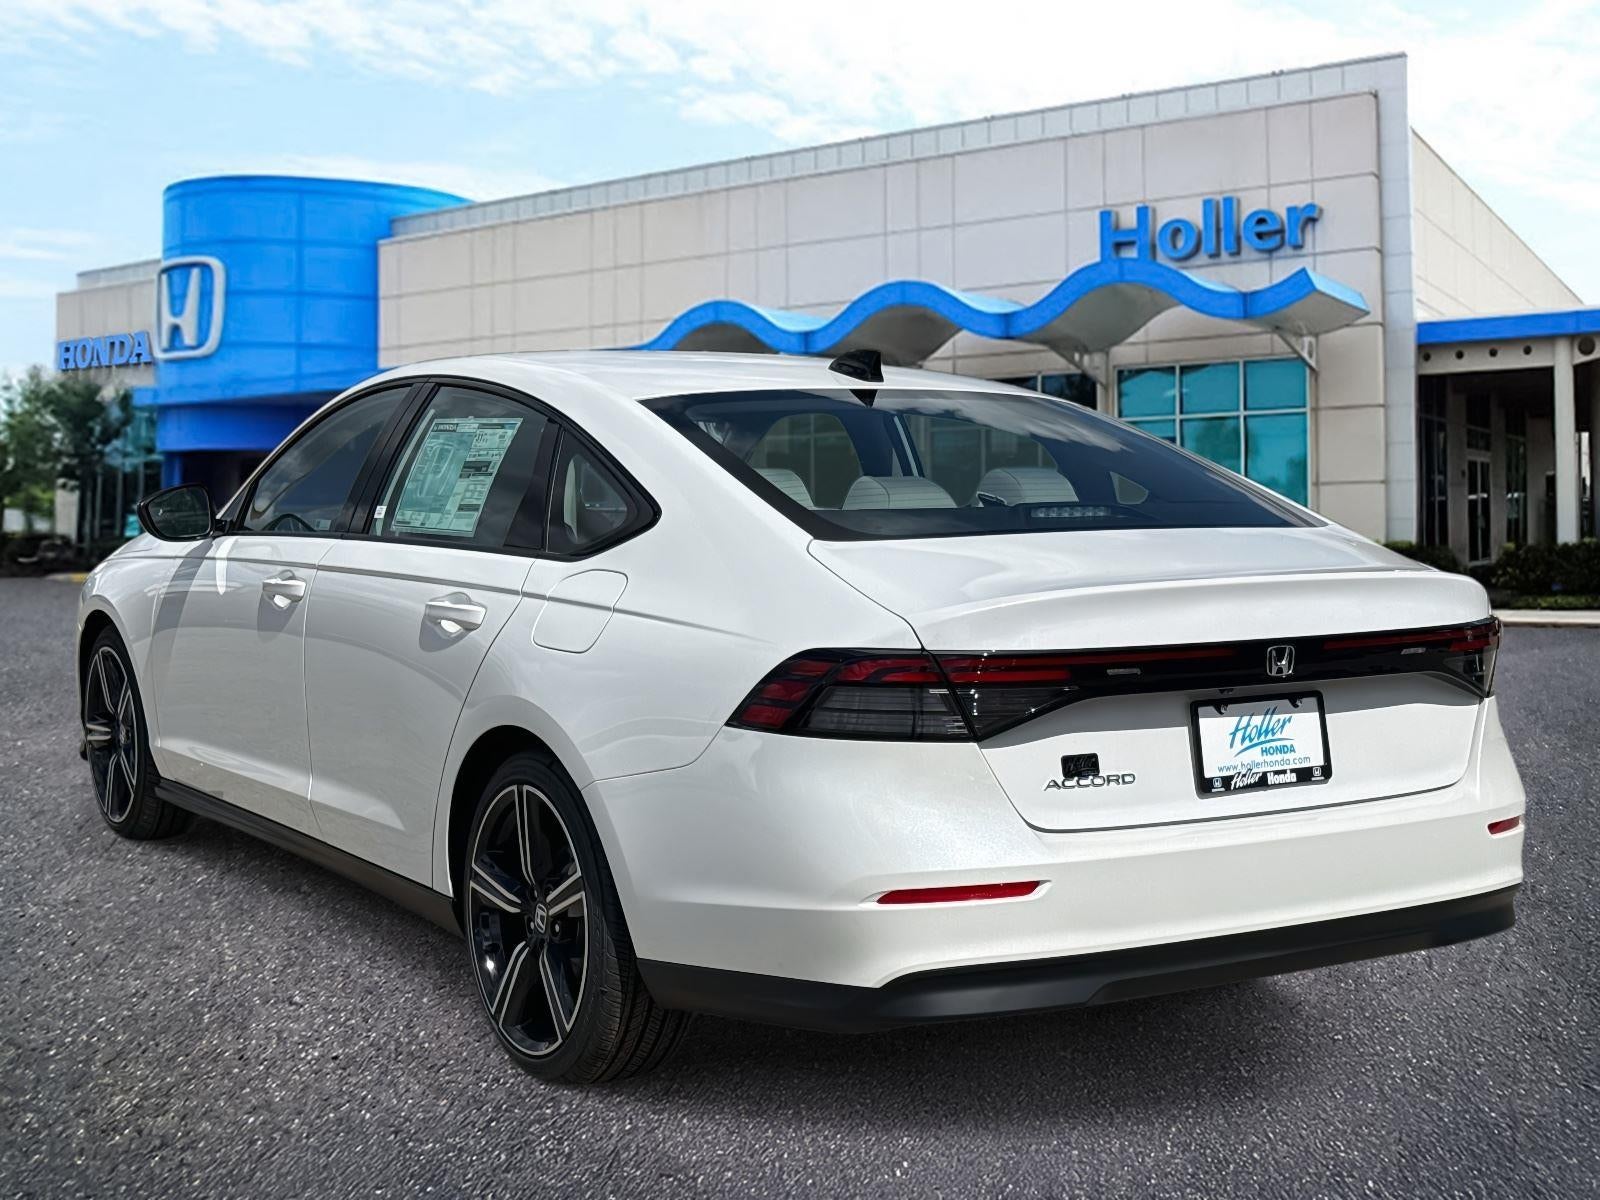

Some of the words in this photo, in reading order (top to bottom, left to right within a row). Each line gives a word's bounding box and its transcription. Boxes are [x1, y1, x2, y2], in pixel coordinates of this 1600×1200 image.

[1099, 196, 1322, 262] Holler
[58, 331, 152, 371] HONDA
[1229, 706, 1292, 749] Holler
[1261, 744, 1296, 757] HONDA
[1217, 756, 1311, 773] www.hollerhonda.com
[1043, 773, 1136, 791] ACCORD
[1230, 768, 1263, 791] Holler
[1267, 769, 1297, 785] Honda
